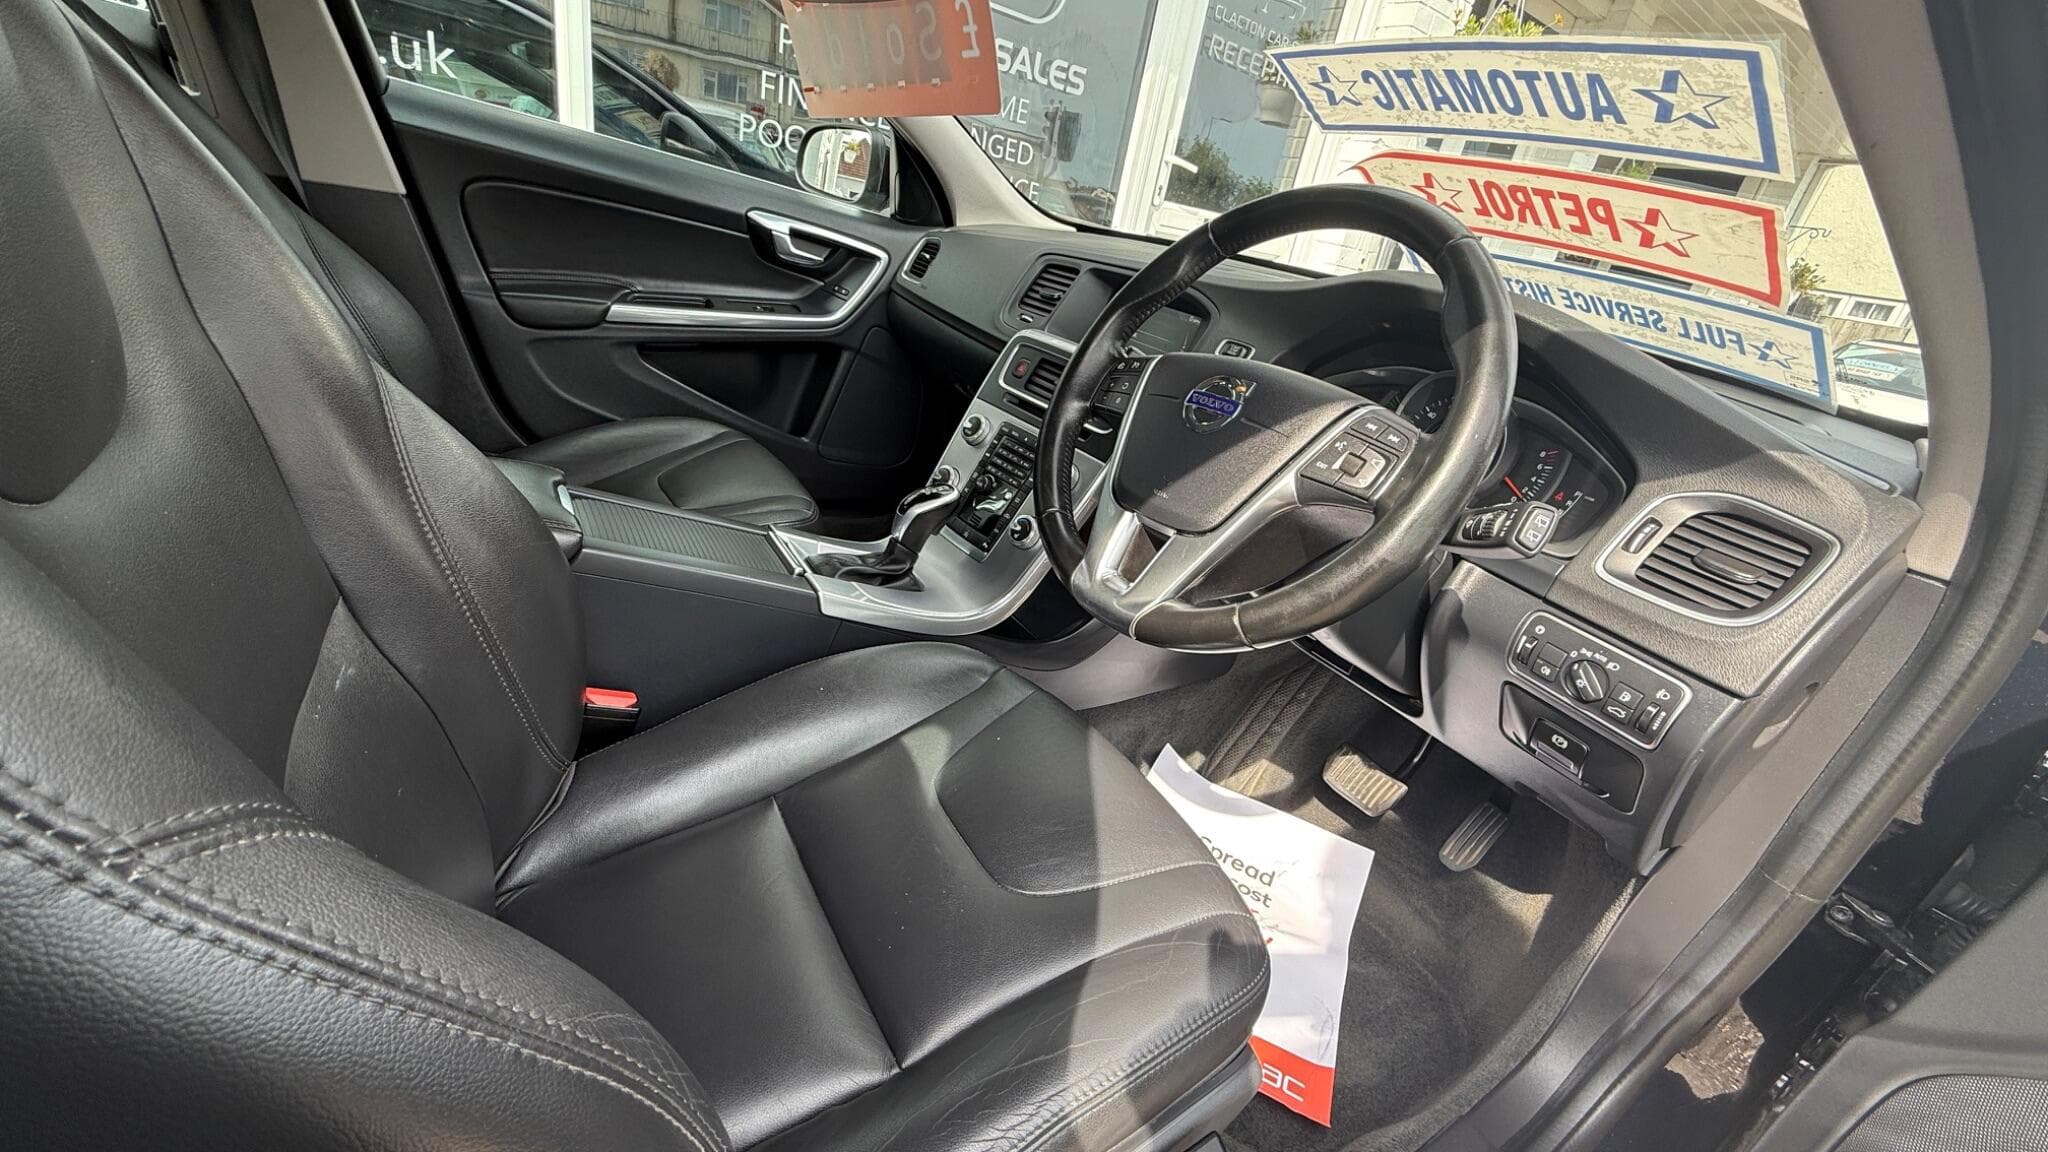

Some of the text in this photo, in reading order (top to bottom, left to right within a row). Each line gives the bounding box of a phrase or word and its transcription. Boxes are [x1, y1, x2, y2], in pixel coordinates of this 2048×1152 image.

[1215, 4, 1266, 39] CLACTON
[994, 37, 1088, 96] SALES
[1208, 33, 1287, 88] RECEP
[1192, 393, 1234, 412] VOLVO
[1230, 878, 1272, 909] ost
